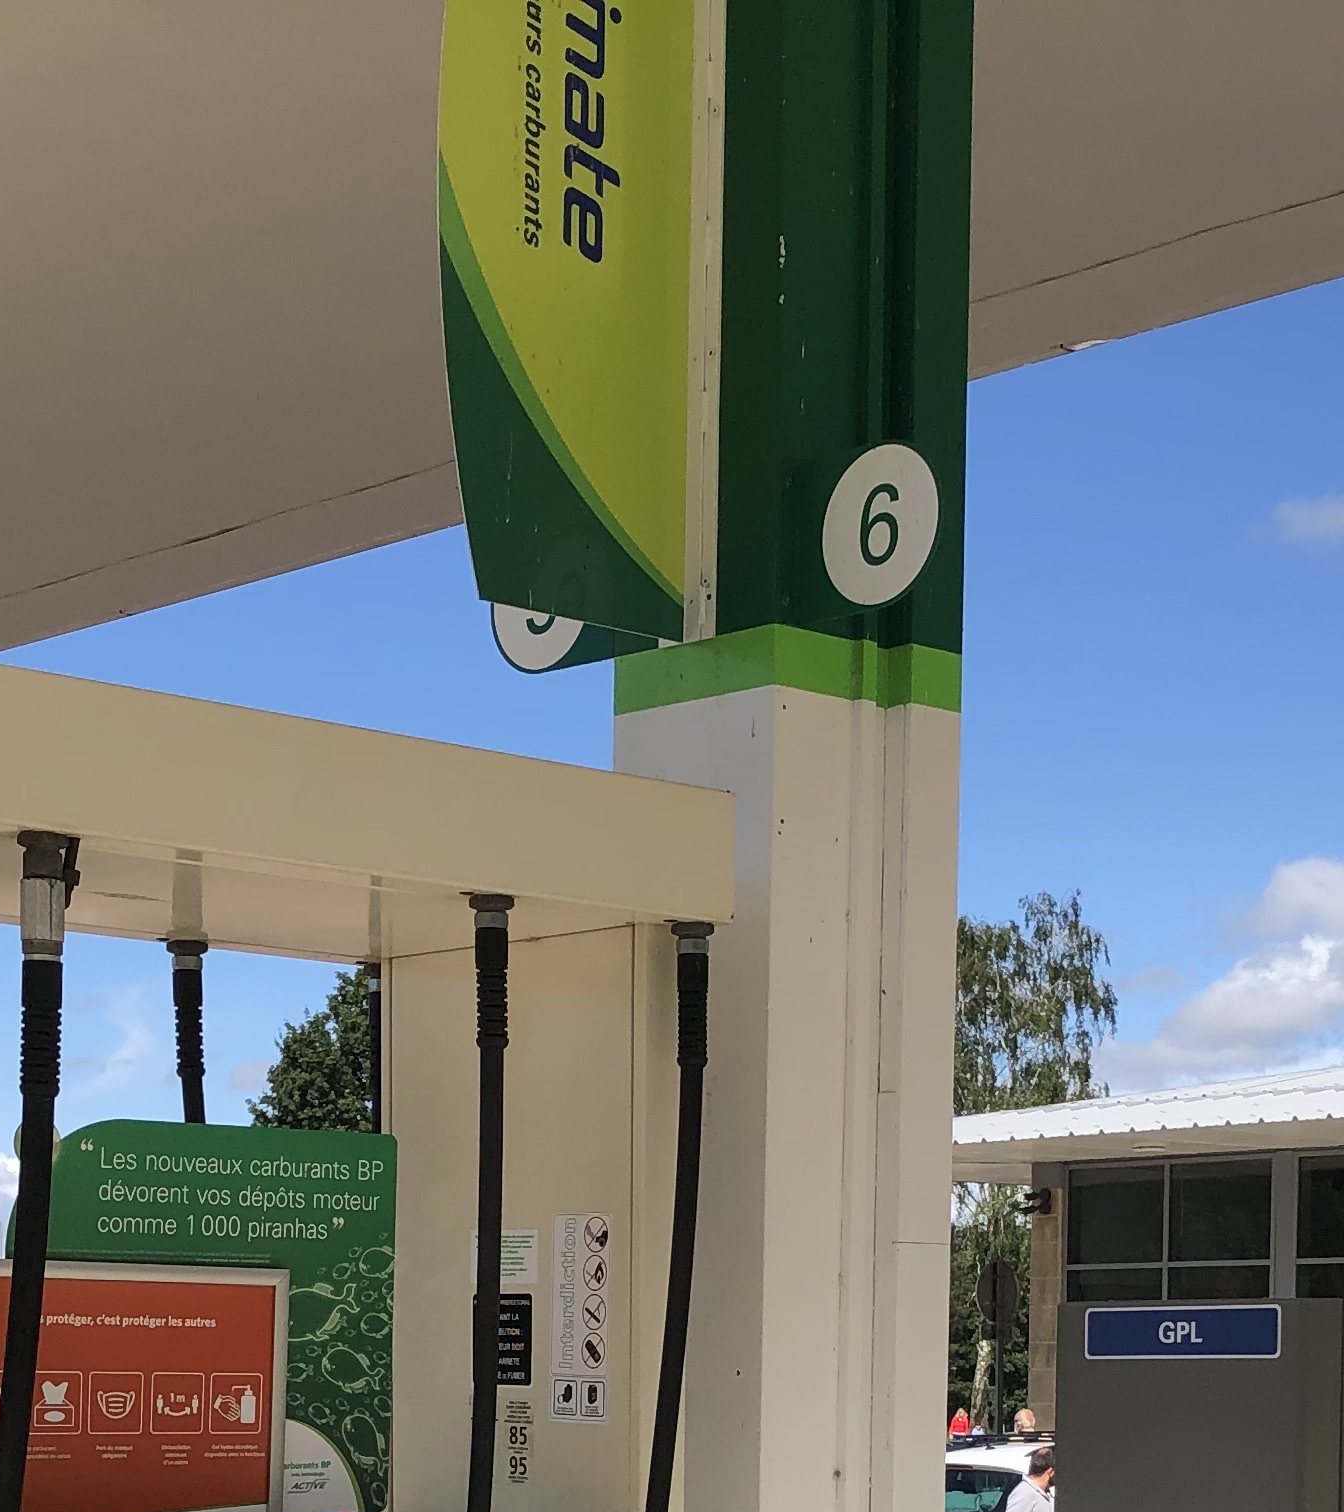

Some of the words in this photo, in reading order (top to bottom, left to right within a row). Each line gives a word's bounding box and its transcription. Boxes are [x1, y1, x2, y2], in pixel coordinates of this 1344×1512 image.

[563, 0, 622, 263] mate
[524, 63, 546, 248] carburants
[859, 483, 899, 566] 6
[100, 1147, 138, 1170] Les
[146, 1153, 243, 1175] nouveaux
[250, 1156, 350, 1180] carburants
[358, 1159, 384, 1181] BP
[99, 1179, 189, 1205] dévorent
[196, 1189, 231, 1206] vos
[239, 1185, 306, 1213] dépôts
[313, 1191, 380, 1211] moteur
[97, 1215, 177, 1236] comme
[558, 1216, 577, 1371] Interdiction
[46, 1313, 94, 1327] protéger,
[96, 1314, 121, 1326] c'est
[122, 1314, 167, 1329] protéger
[168, 1315, 183, 1327] les
[184, 1316, 217, 1328] autres
[1158, 1320, 1204, 1344] GPL
[509, 1426, 527, 1445] 85
[284, 1461, 319, 1470] arburants
[509, 1456, 527, 1475] 95
[291, 1481, 328, 1490] ACTIVE
